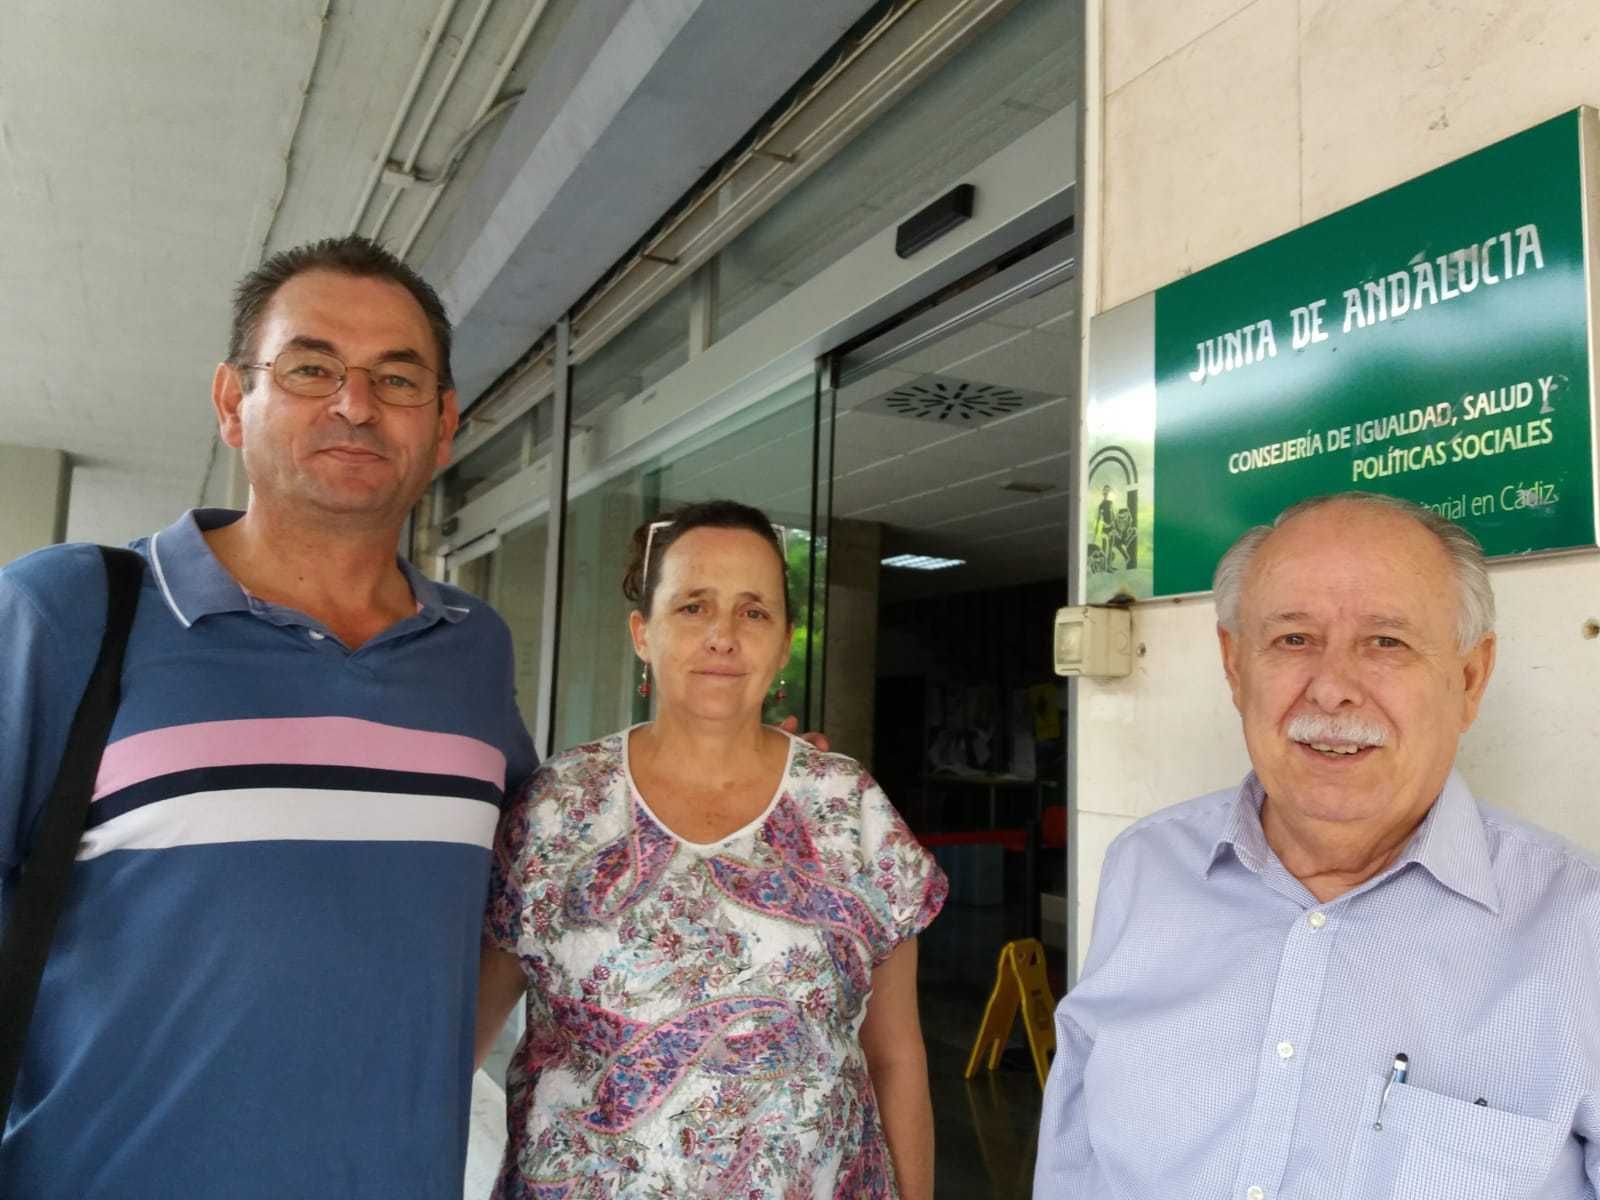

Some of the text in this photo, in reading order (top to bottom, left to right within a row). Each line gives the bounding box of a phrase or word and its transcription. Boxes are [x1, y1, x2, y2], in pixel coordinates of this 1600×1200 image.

[1189, 319, 1277, 382] JUNTA
[1290, 299, 1328, 350] DE
[1229, 375, 1553, 474] CONSEJERÍA DE IGUALDAD, SALUD Y
[1353, 418, 1552, 482] POLÍTICAS SOCIALES
[1471, 494, 1494, 516] en
